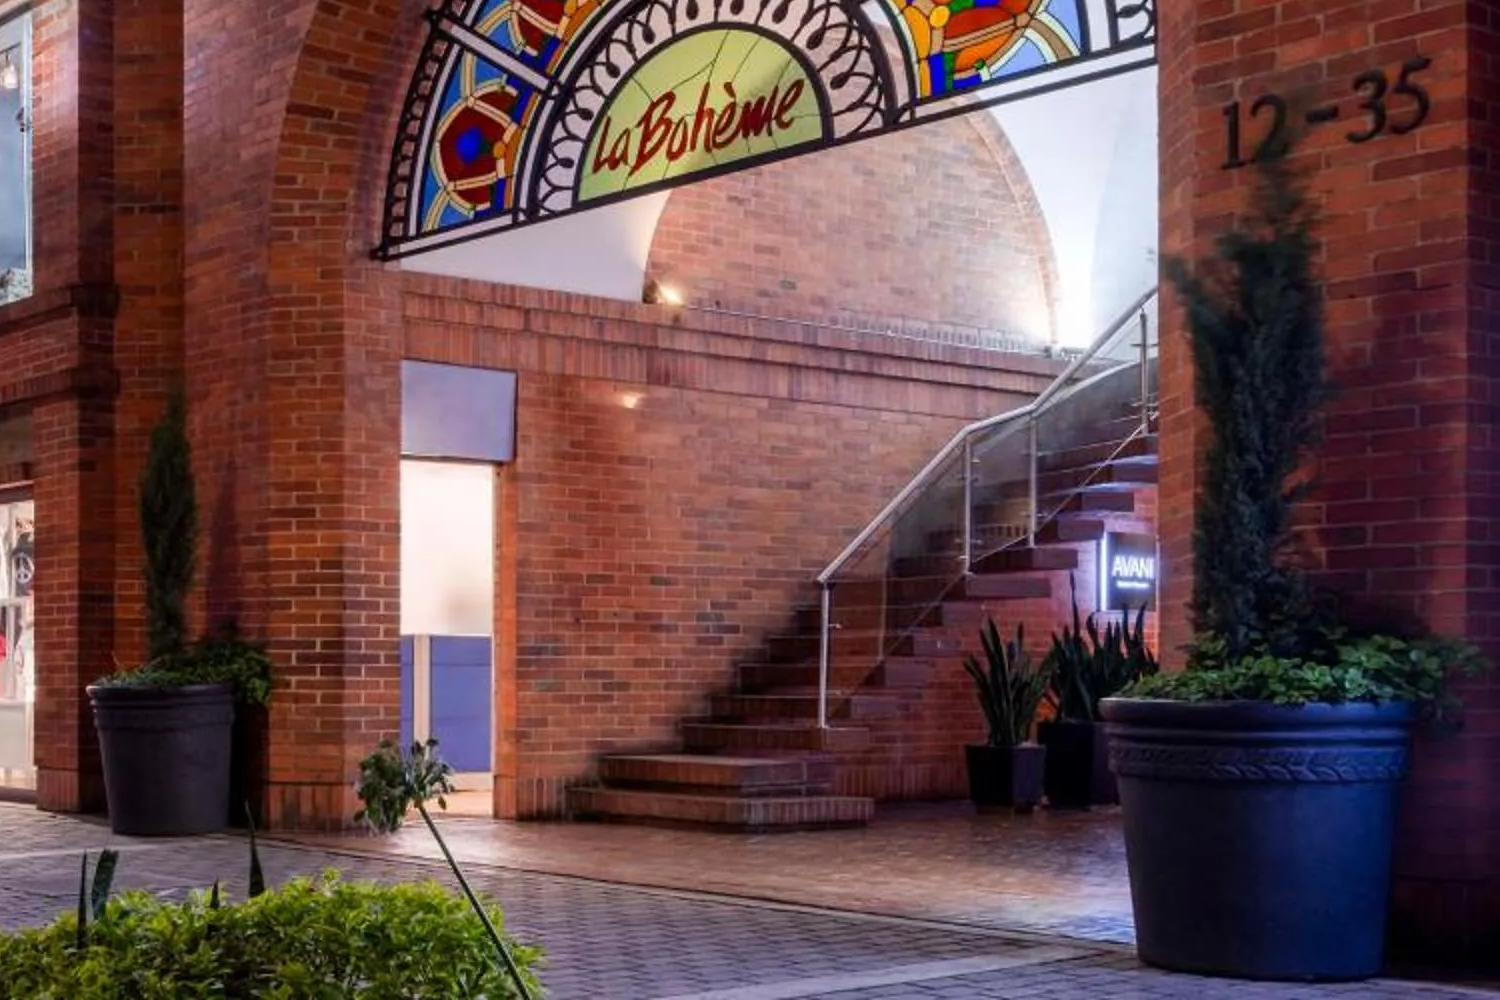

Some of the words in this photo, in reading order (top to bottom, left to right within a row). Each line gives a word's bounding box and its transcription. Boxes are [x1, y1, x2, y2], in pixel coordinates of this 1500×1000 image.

[628, 78, 805, 177] Bohème
[1219, 54, 1432, 171] 12-35
[1112, 554, 1155, 580] AVANI
